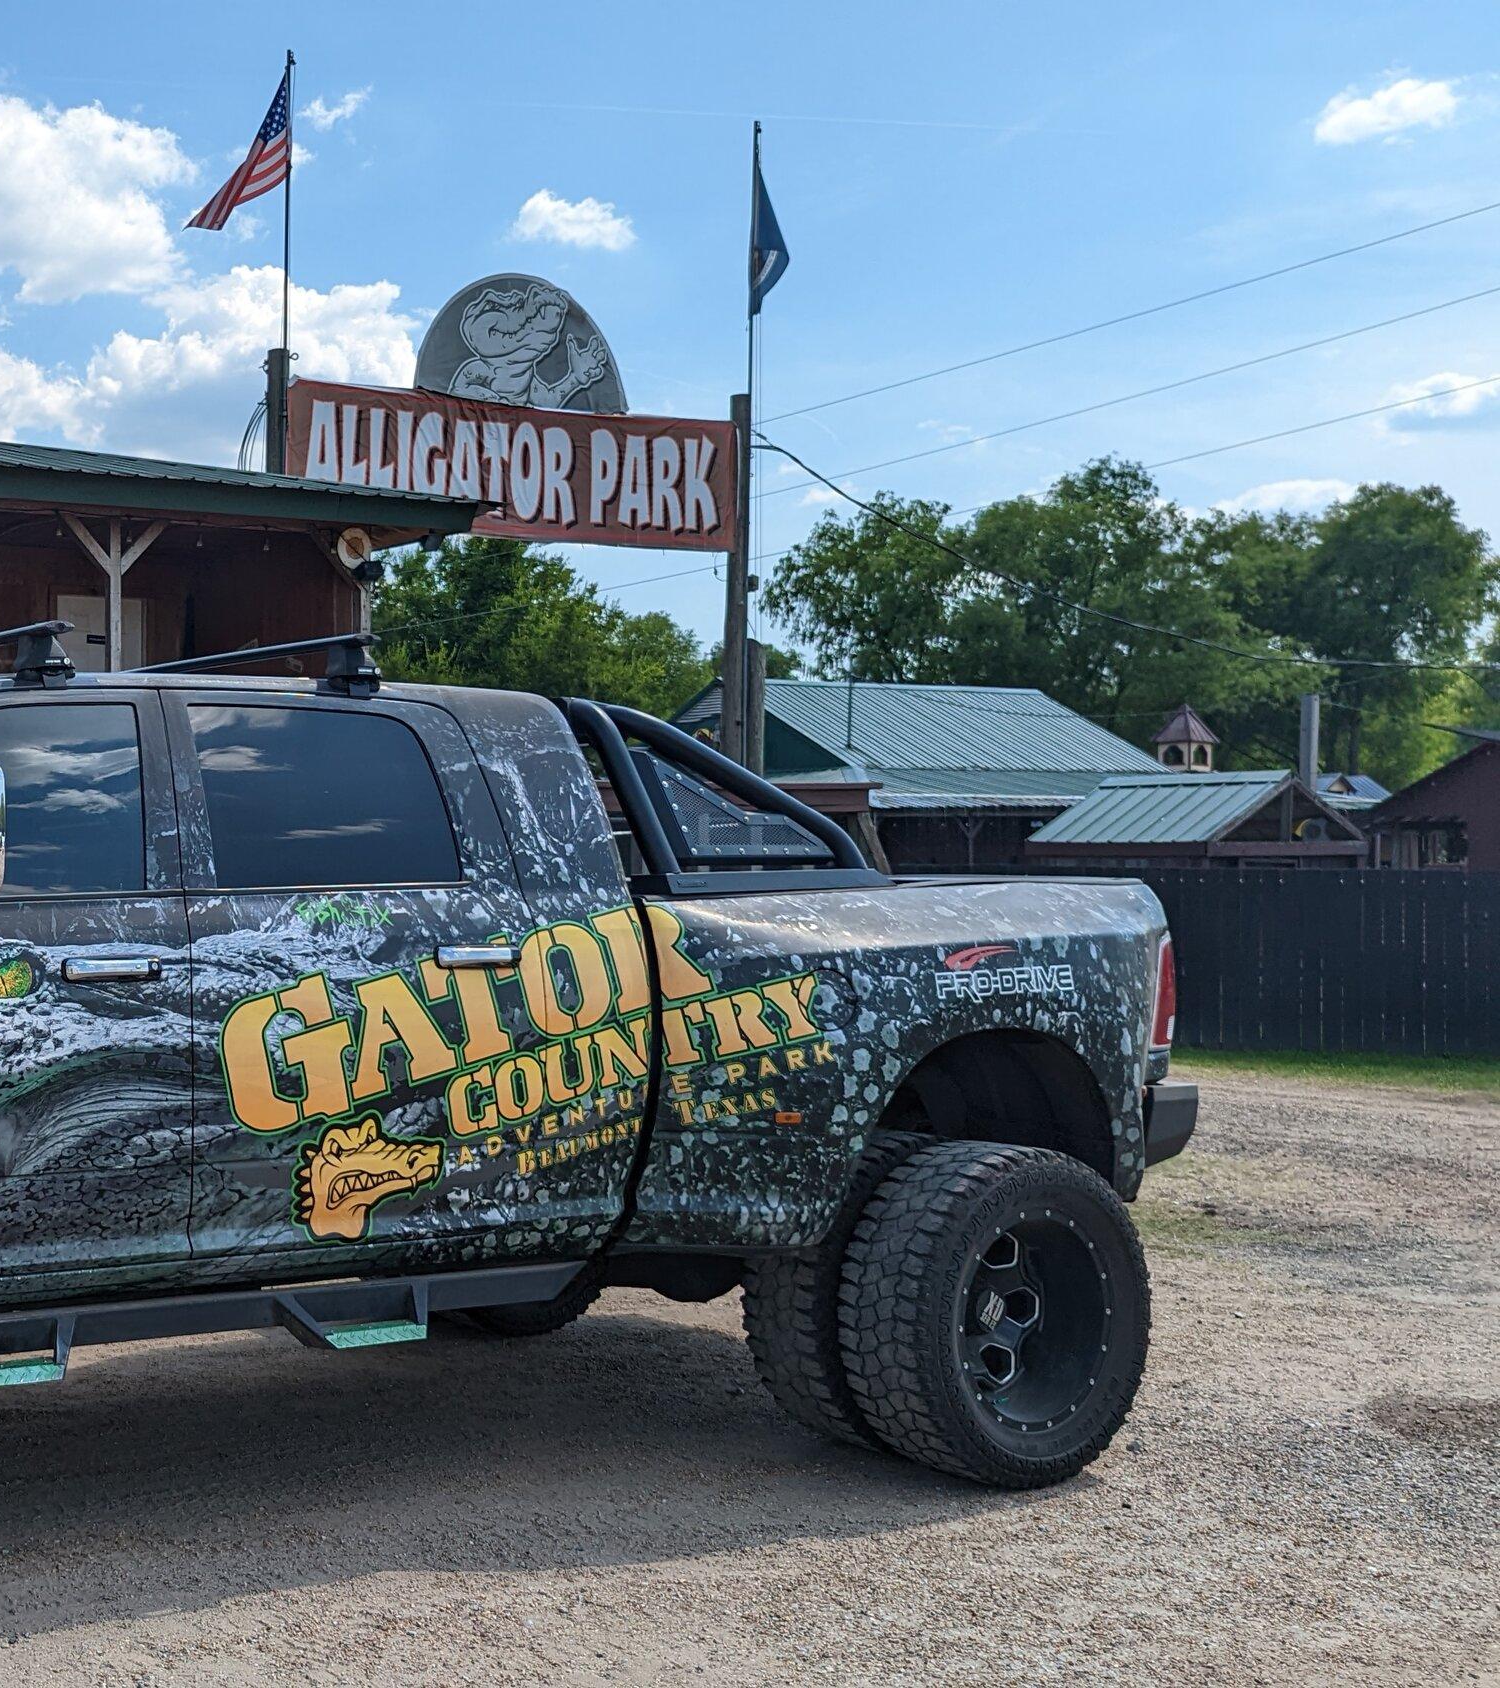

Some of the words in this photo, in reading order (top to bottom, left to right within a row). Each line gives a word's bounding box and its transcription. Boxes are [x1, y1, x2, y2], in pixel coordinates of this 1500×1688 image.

[305, 400, 577, 529] ALLIGATOR
[590, 429, 720, 534] PARK
[221, 905, 712, 1135] GATOR
[935, 964, 1075, 1003] PRO-DRIVE
[447, 972, 819, 1138] COUNTRY
[457, 1072, 694, 1166] ADVENTUE
[726, 1042, 837, 1086] PARK
[983, 1291, 1004, 1322] XD
